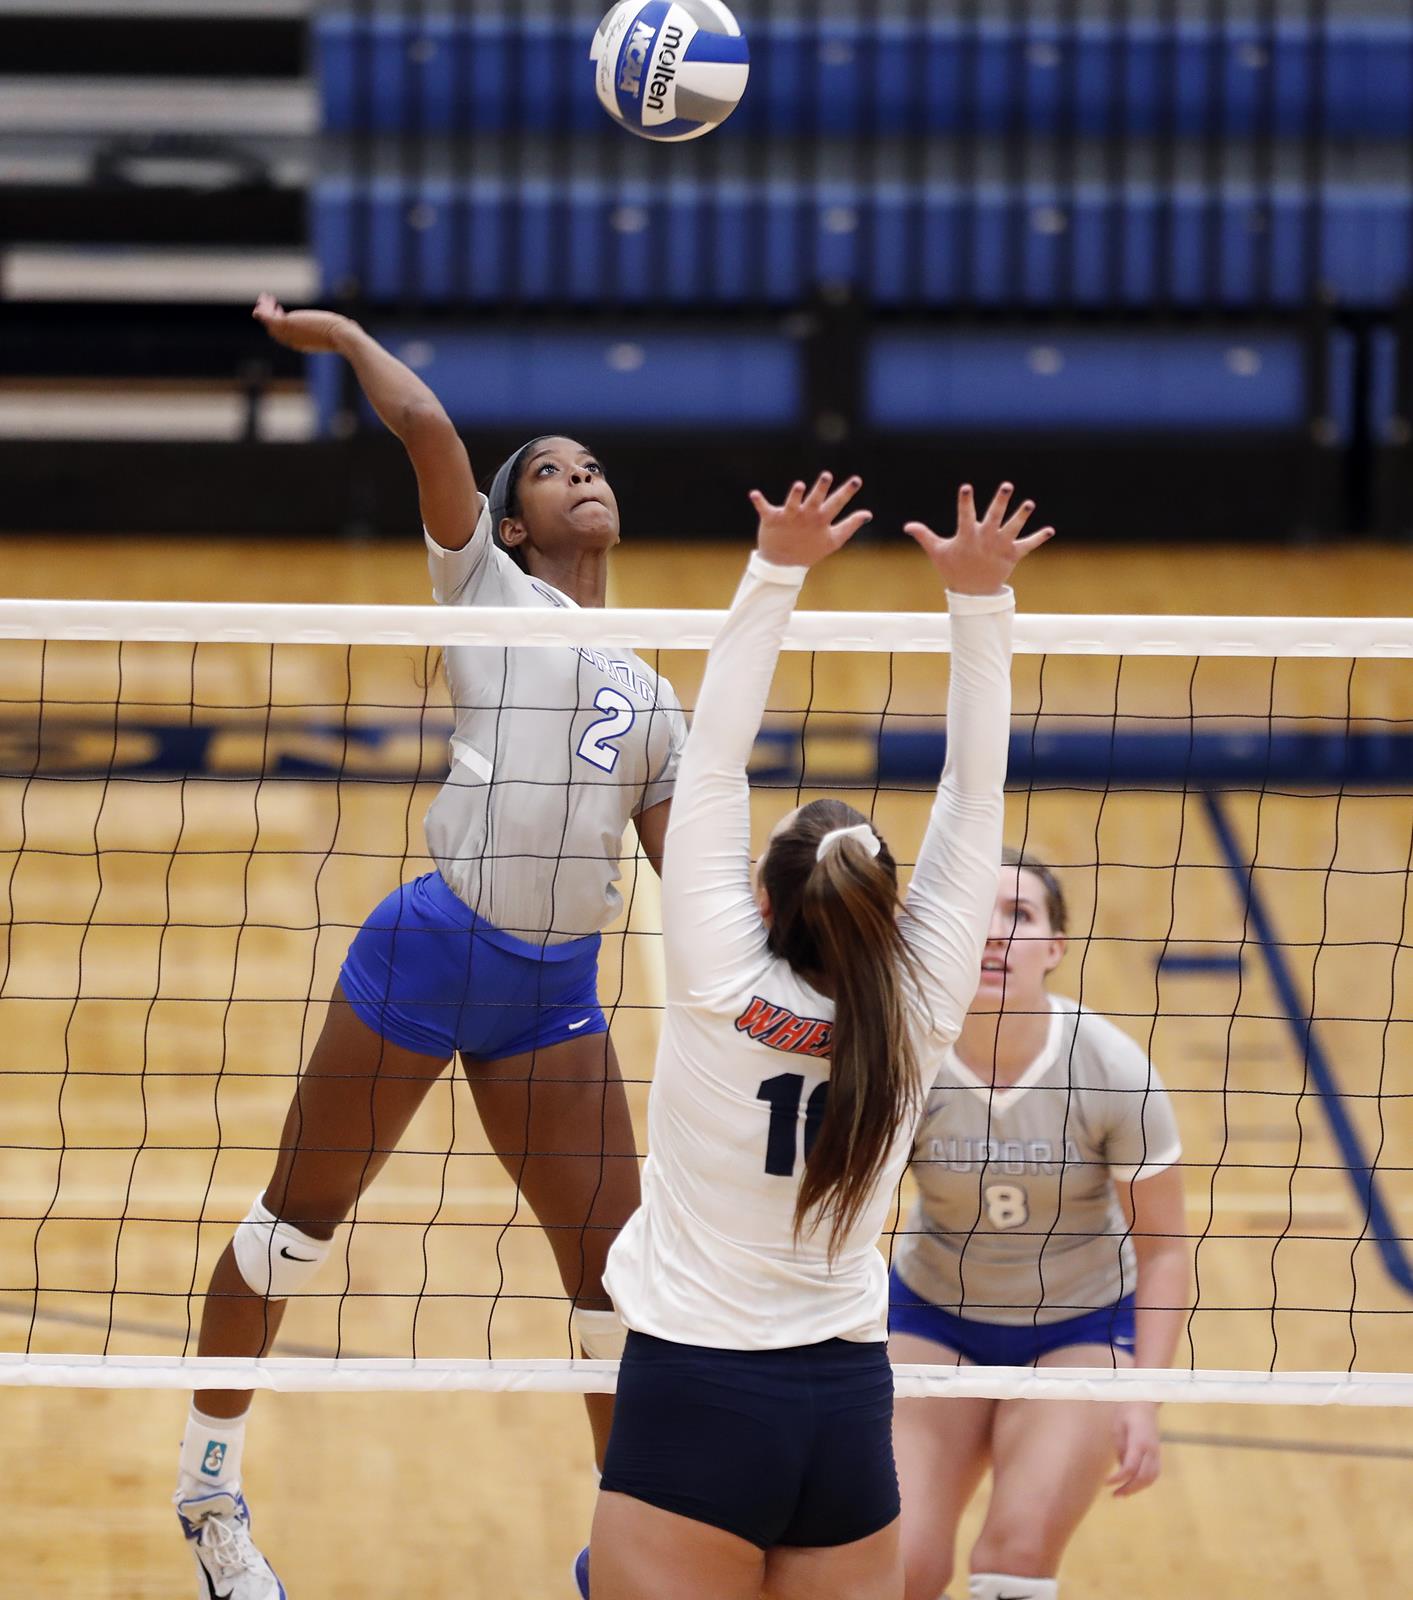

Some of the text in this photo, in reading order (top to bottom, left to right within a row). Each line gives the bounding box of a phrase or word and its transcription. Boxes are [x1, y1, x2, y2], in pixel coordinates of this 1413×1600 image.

[620, 20, 656, 98] NCAA
[646, 25, 684, 112] molten
[576, 687, 636, 774] 2
[735, 996, 833, 1059] WHE
[927, 1138, 1084, 1176] AURORA
[985, 1184, 1029, 1231] 8
